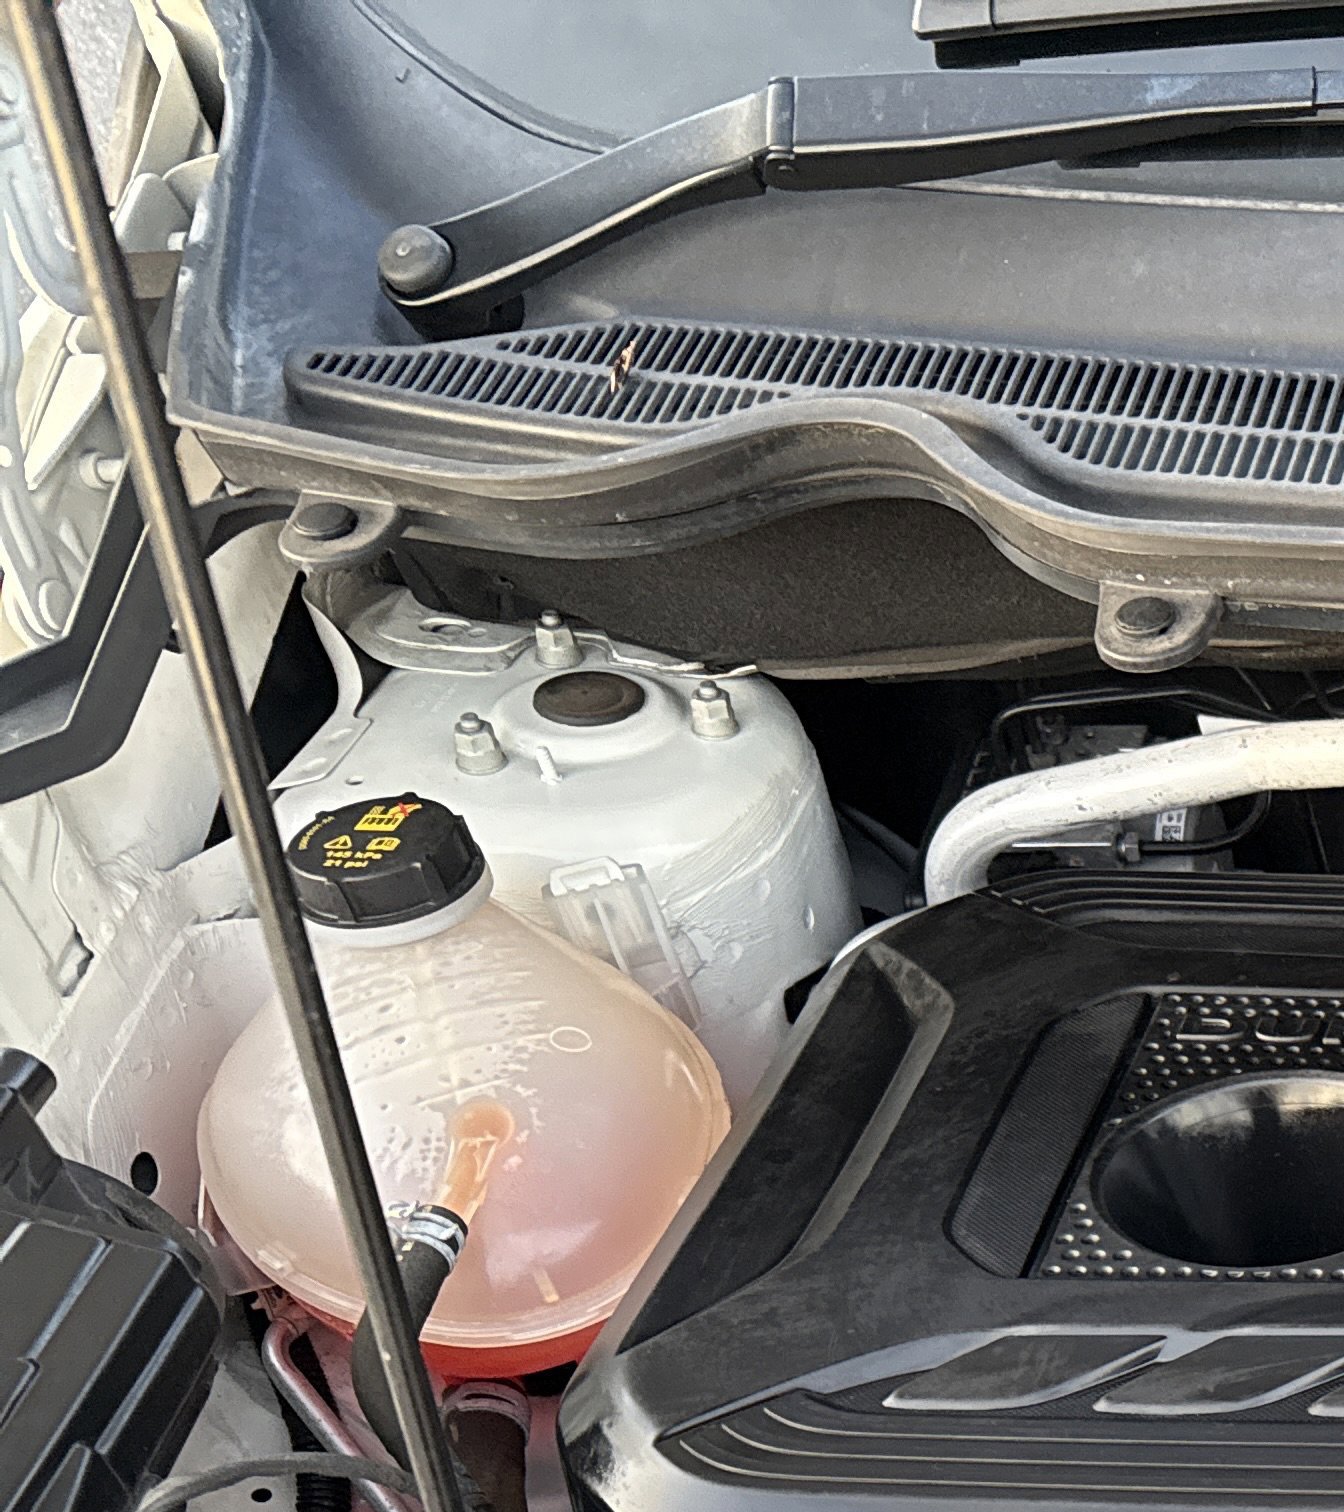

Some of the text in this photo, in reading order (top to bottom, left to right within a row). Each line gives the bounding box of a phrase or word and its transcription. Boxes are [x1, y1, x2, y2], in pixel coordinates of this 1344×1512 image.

[354, 850, 383, 859] kPa
[322, 859, 369, 868] 21 psi
